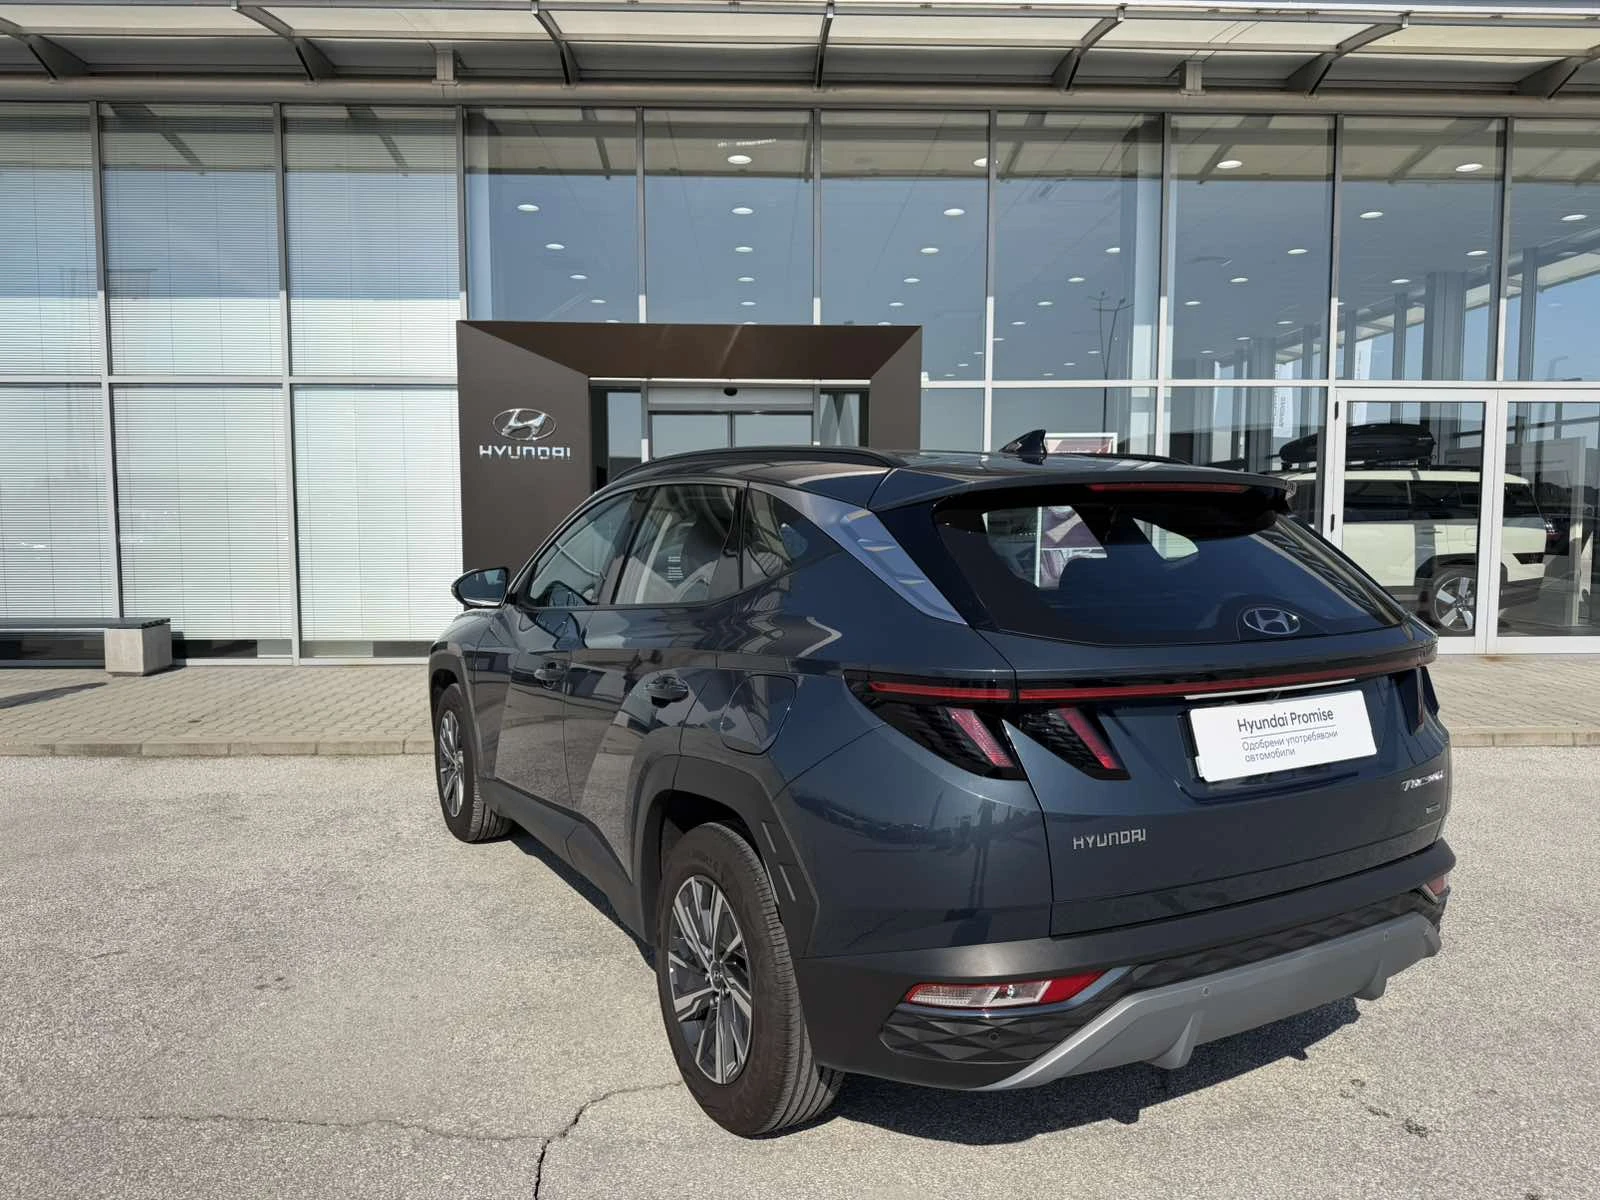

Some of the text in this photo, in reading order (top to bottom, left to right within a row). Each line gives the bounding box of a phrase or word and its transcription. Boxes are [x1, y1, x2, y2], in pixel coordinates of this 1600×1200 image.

[479, 445, 571, 459] HYUNDAI
[1237, 707, 1334, 734] Hyundai Promise
[1241, 739, 1285, 752] Одобрени
[1244, 747, 1296, 763] автомобили
[1073, 828, 1146, 850] HYUNDAI
